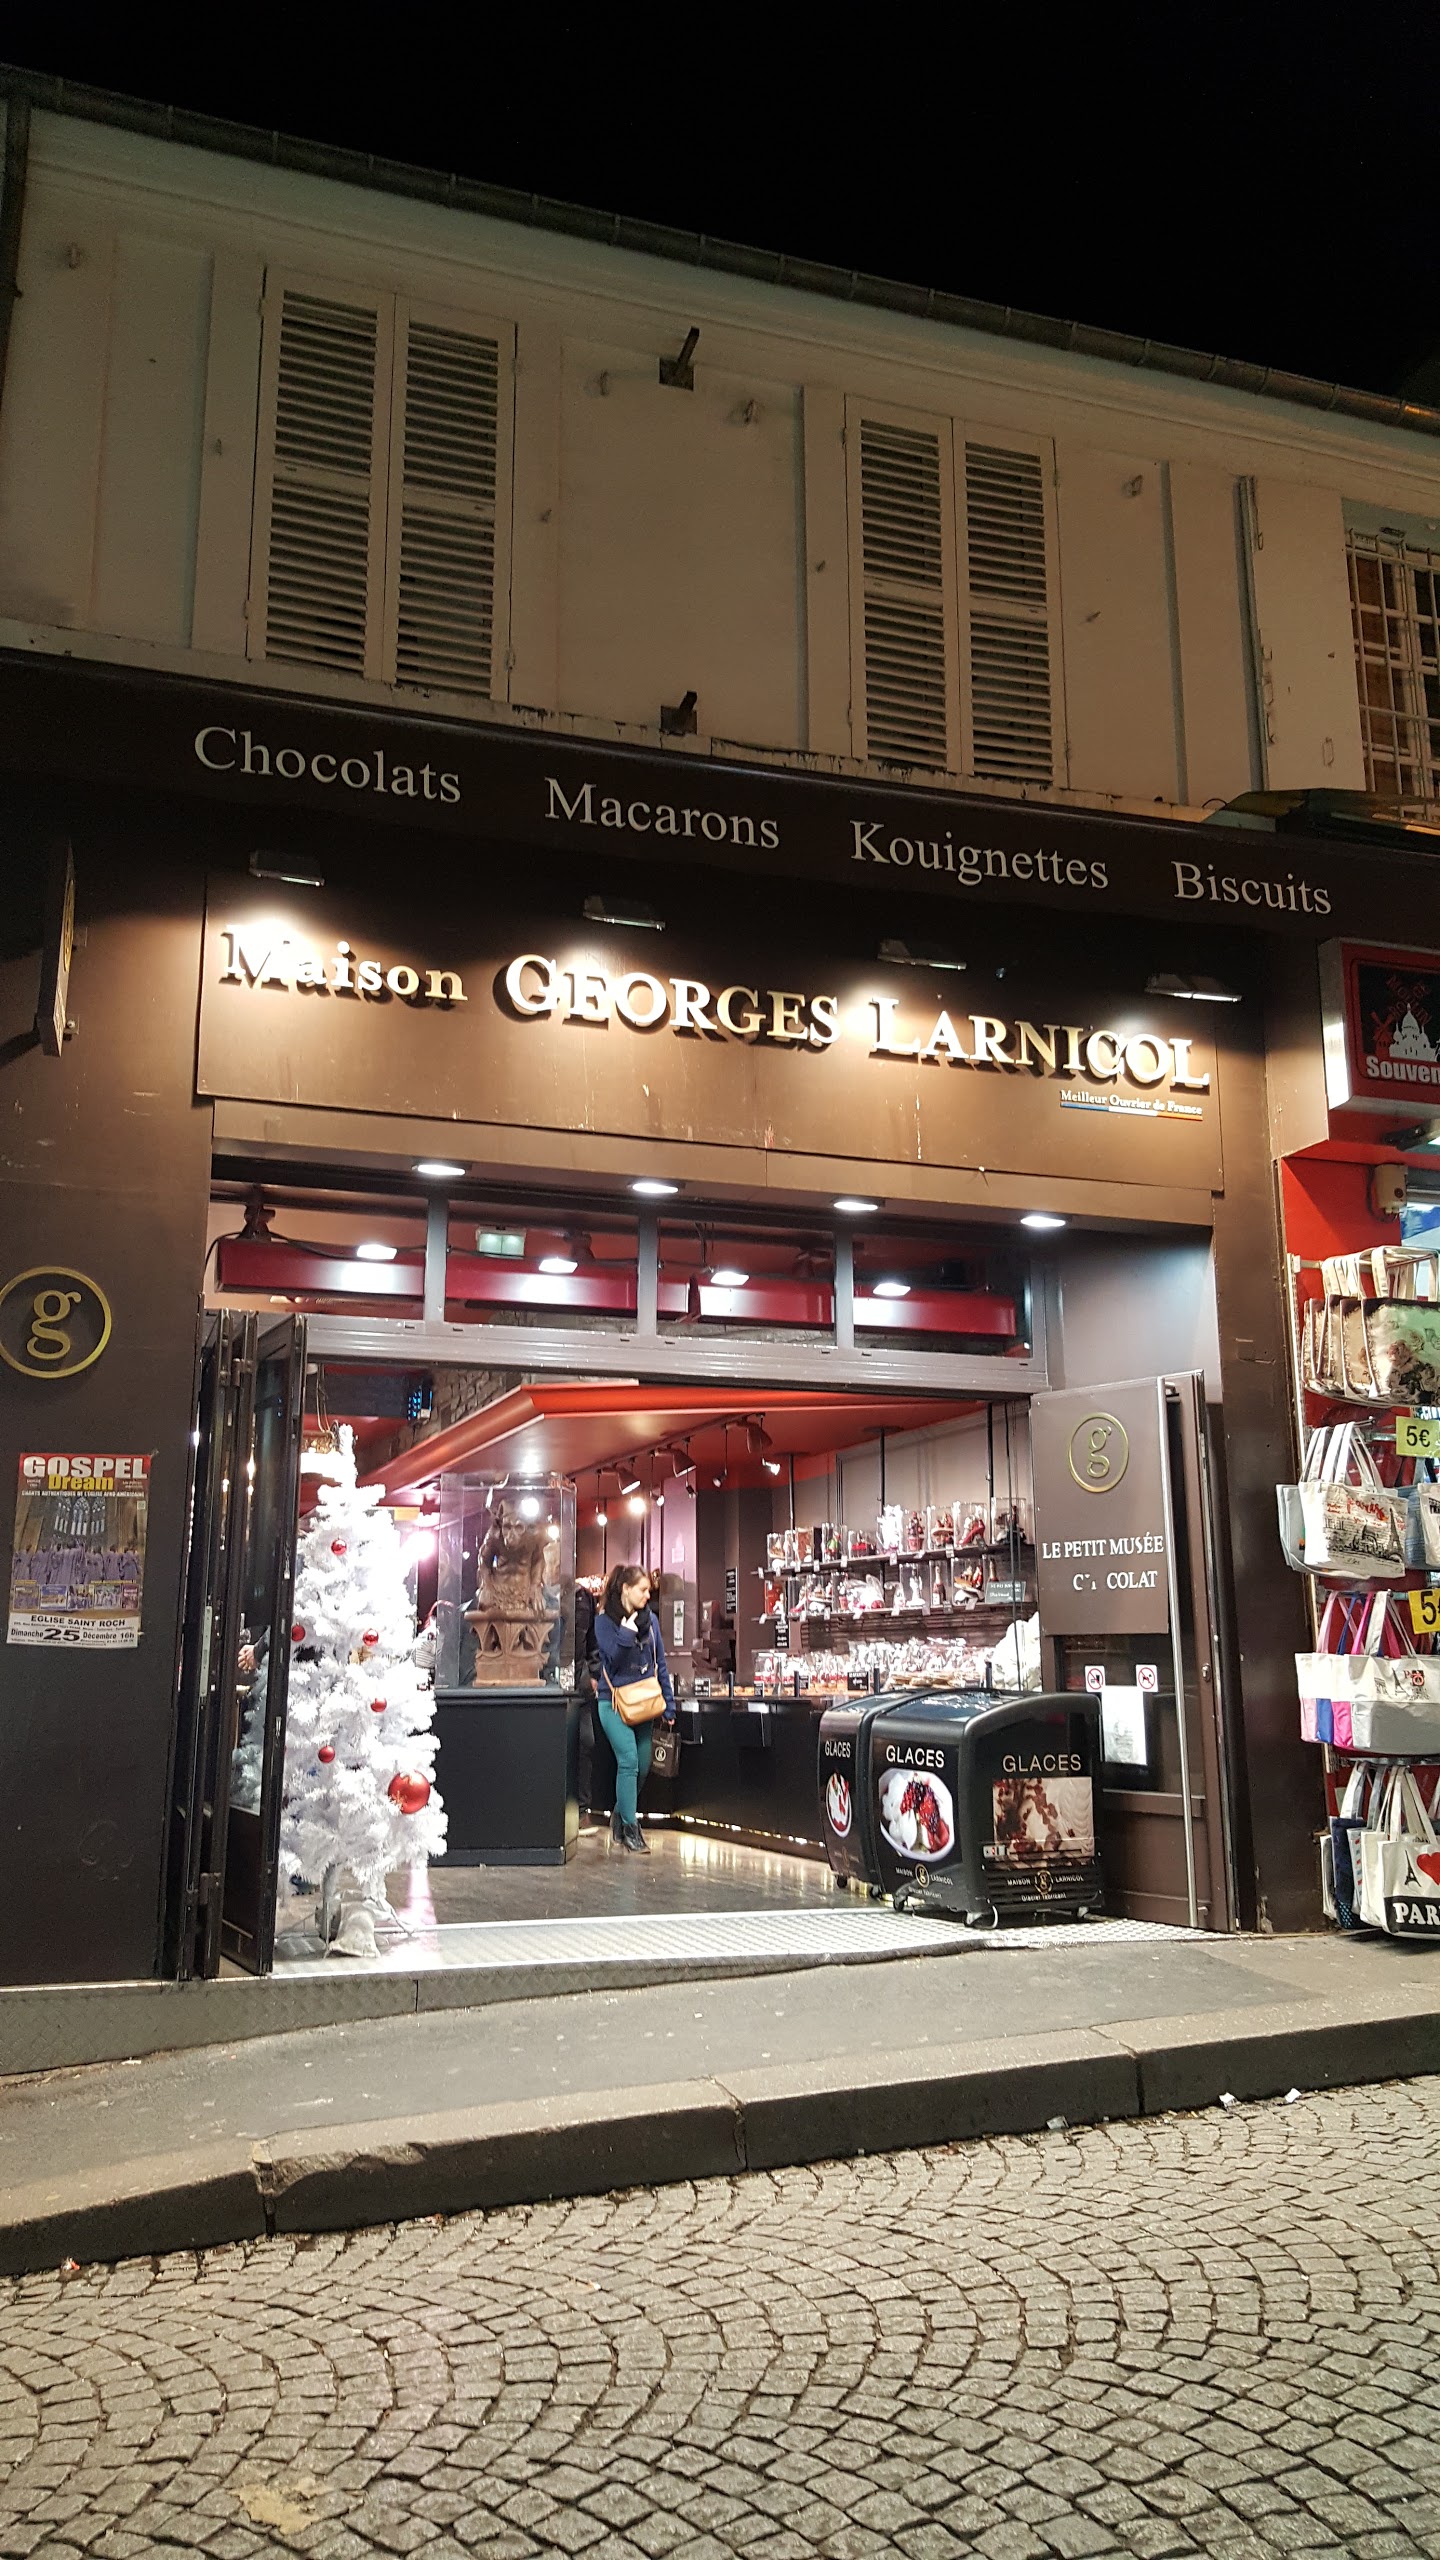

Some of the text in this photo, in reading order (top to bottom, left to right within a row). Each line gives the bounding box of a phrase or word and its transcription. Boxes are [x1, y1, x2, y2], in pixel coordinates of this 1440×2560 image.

[194, 726, 1332, 914] Chocolats Macarons Kouignettes Biscuits
[222, 925, 1210, 1086] Maison GEORGES LARNICOL
[1060, 1090, 1203, 1115] Meilleur Ouvrier de France
[27, 1290, 82, 1360] g
[1406, 1425, 1431, 1447] 5€
[1086, 1426, 1112, 1478] g
[23, 1456, 147, 1479] GOSPEL
[48, 1474, 114, 1491] Dream
[1042, 1532, 1164, 1558] LE PETIT MUSÉE
[1073, 1571, 1158, 1590] CCOLAT
[1421, 1591, 1440, 1625] 5
[31, 1615, 65, 1624] EGLISE
[68, 1618, 96, 1627] SAINT
[11, 1628, 44, 1638] Dimanche
[43, 1628, 80, 1641] 25
[825, 1741, 851, 1758] GLACES
[886, 1745, 945, 1768] GLACES
[1002, 1754, 1082, 1772] GLACES
[1055, 1875, 1084, 1883] LARNICOL
[1392, 1902, 1440, 1926] PAR
